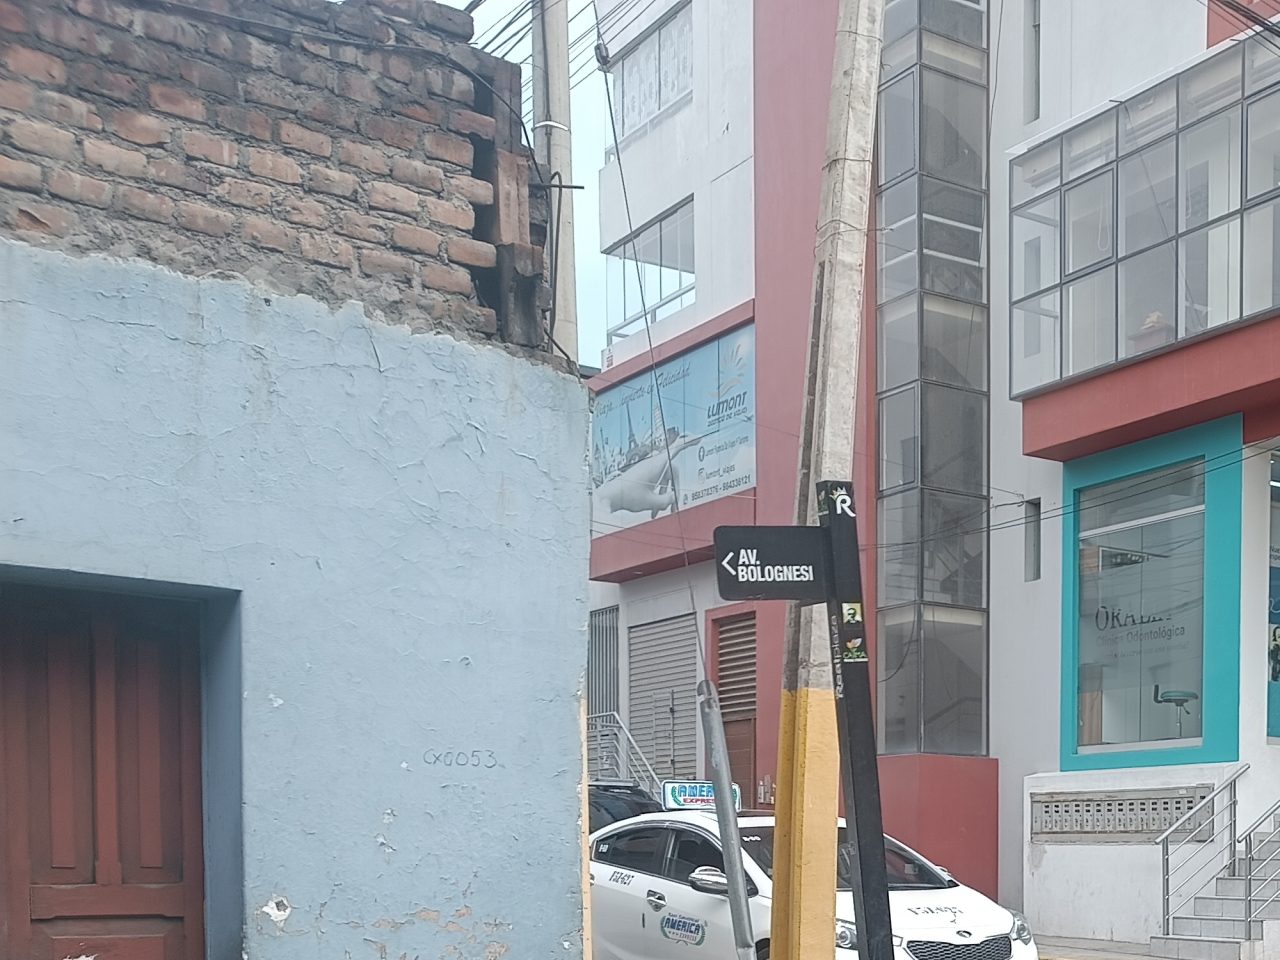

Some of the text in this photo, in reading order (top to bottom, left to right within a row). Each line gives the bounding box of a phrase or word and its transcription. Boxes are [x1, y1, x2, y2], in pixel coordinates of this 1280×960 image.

[738, 549, 760, 565] AV.
[737, 565, 814, 581] BOLOGNESI
[1126, 625, 1185, 642] Odontológica
[663, 917, 701, 936] AMERICA
